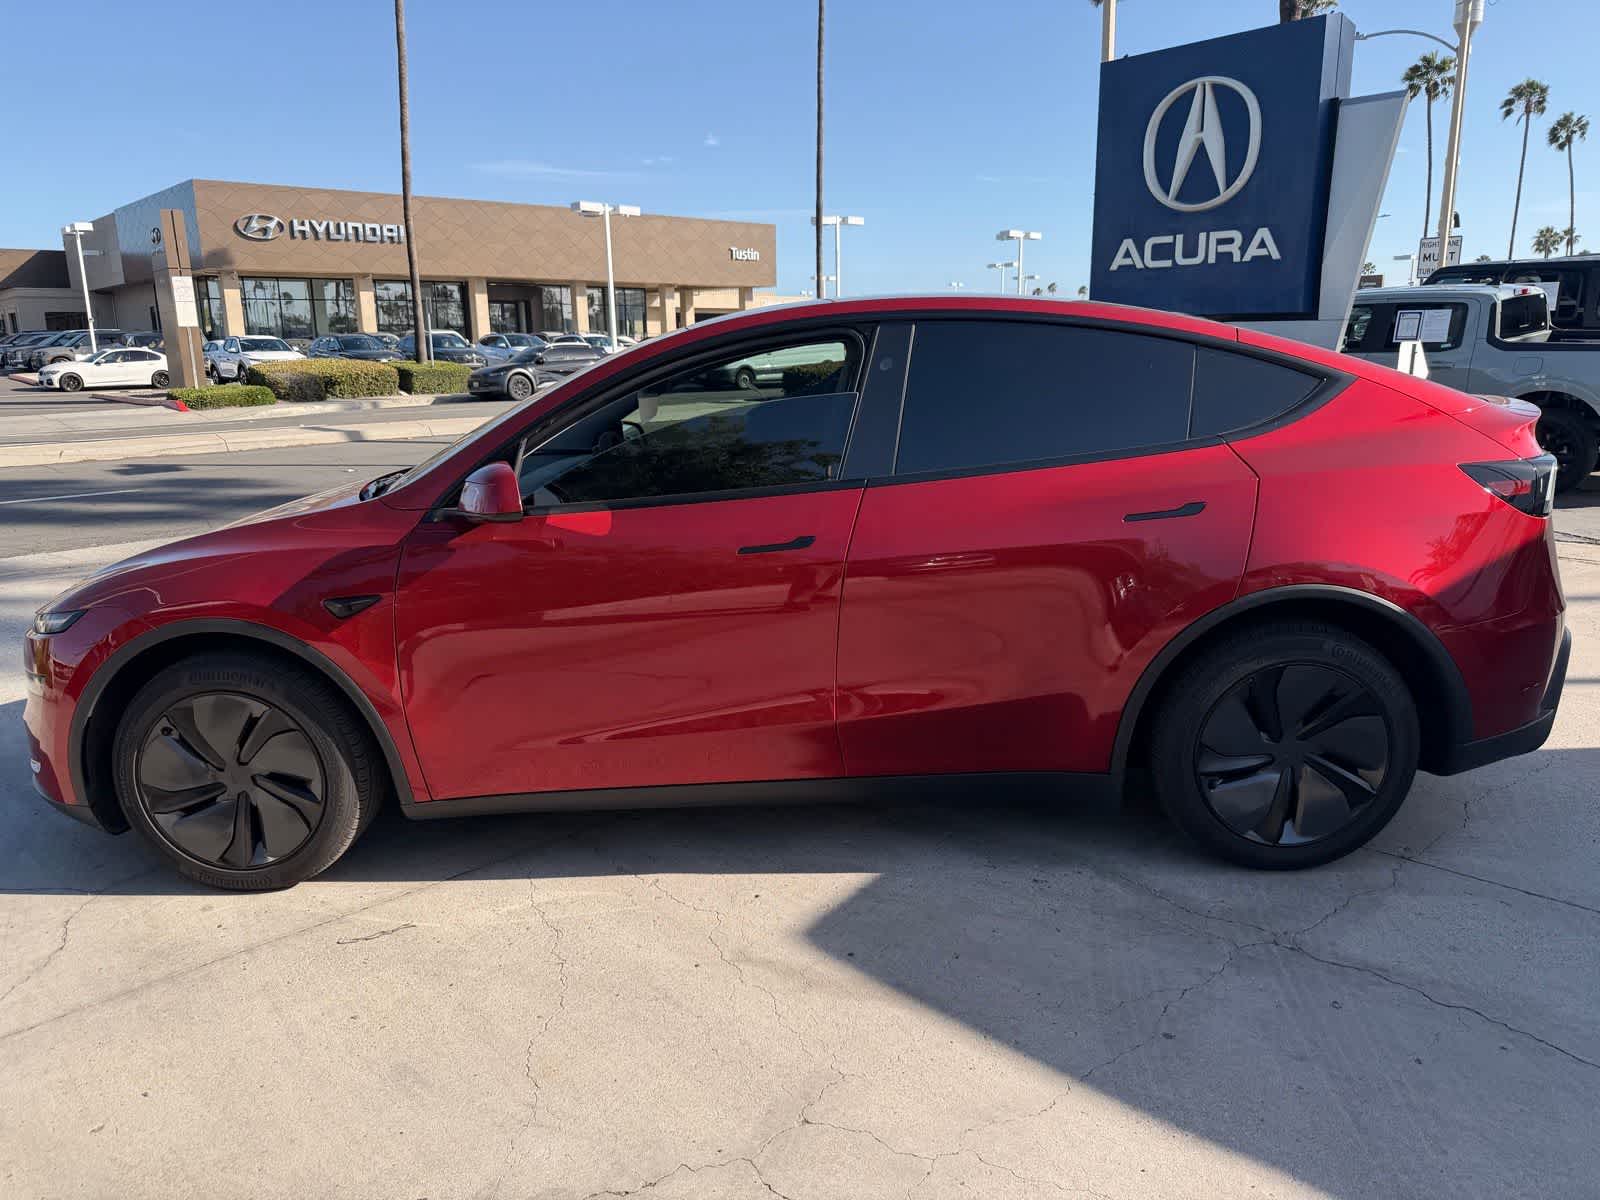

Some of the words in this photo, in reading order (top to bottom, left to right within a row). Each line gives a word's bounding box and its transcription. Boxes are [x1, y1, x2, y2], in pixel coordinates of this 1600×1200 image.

[291, 218, 406, 243] HYUNDAI
[1108, 227, 1281, 271] ACURA
[1421, 240, 1441, 249] RIGHT
[730, 247, 760, 261] Tustin
[1423, 252, 1456, 262] MUT
